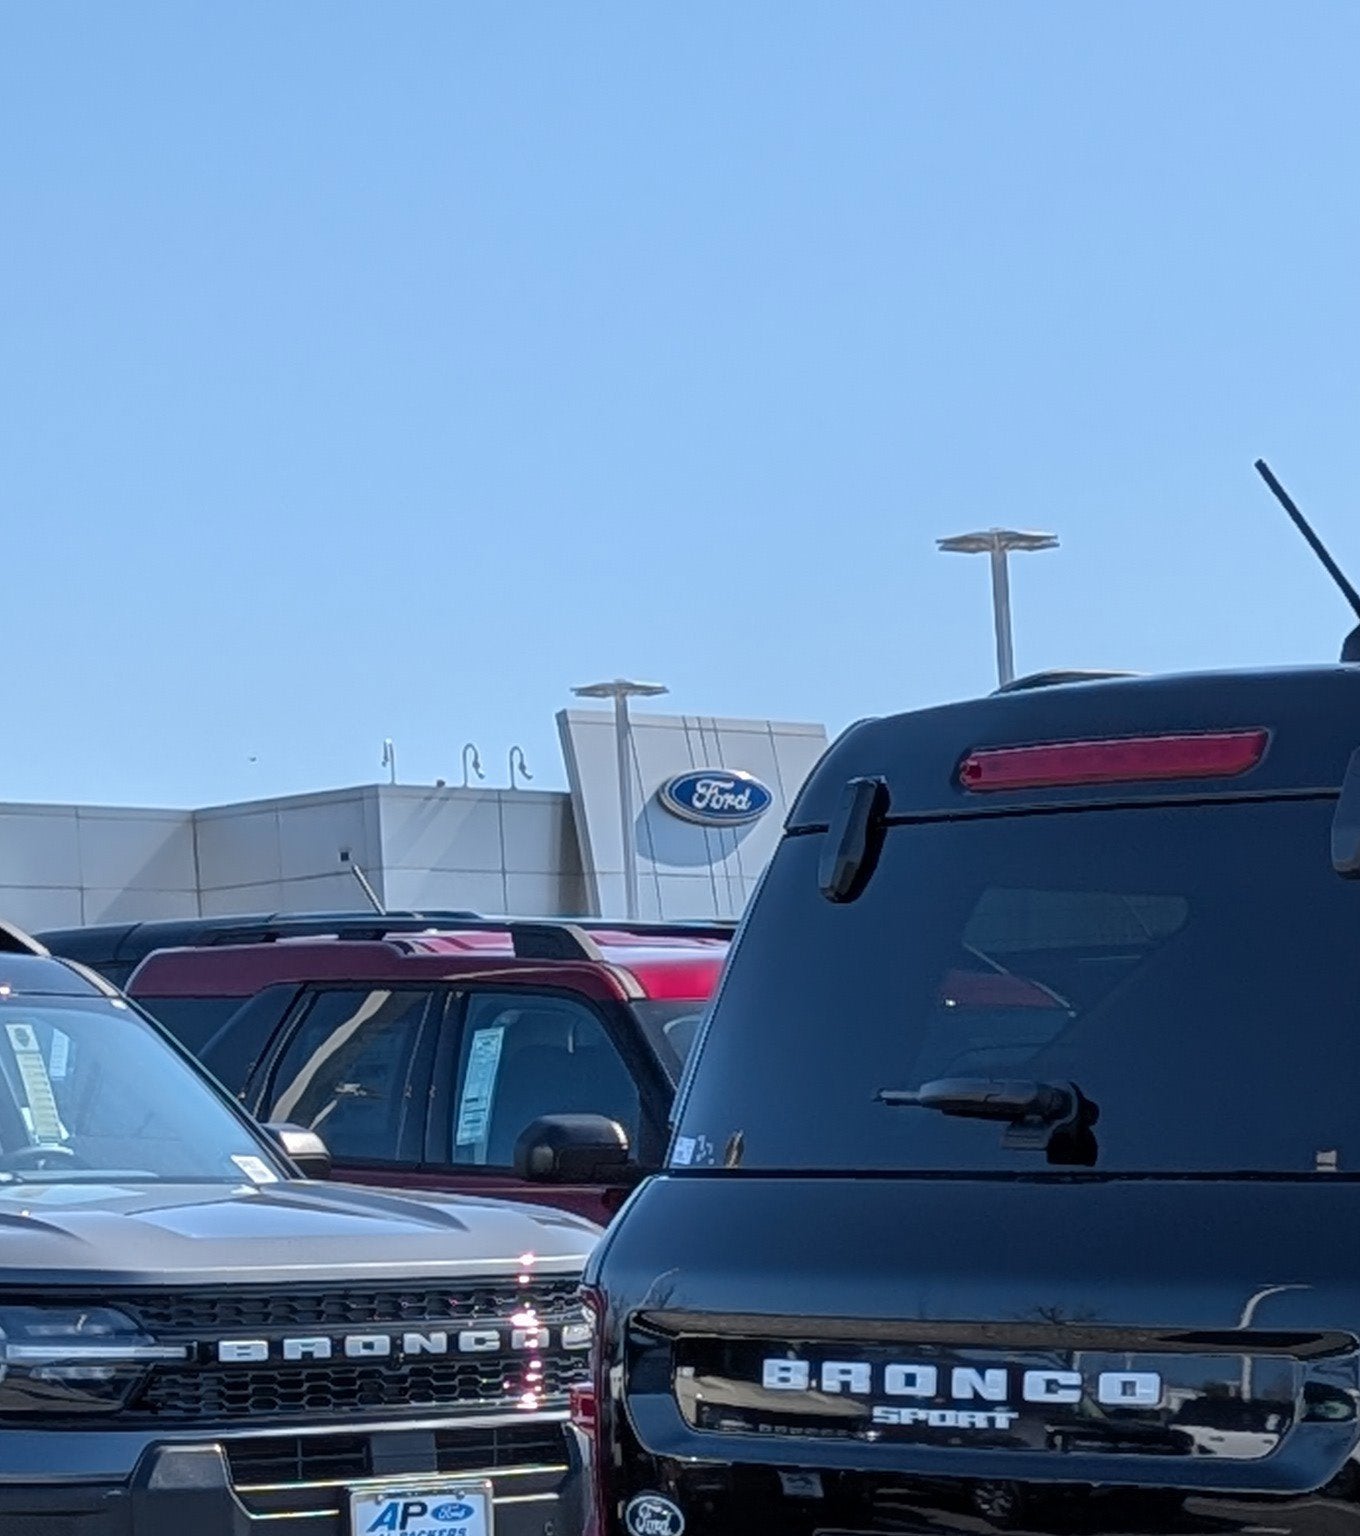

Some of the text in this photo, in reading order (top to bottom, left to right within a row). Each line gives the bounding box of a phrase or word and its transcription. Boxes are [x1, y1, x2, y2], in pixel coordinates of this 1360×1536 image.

[692, 779, 752, 810] Ford
[218, 1327, 550, 1362] BRONCO
[762, 1358, 1161, 1405] BRONCO
[872, 1406, 1019, 1430] SPORT
[366, 1501, 428, 1533] AP
[634, 1502, 674, 1536] Ford
